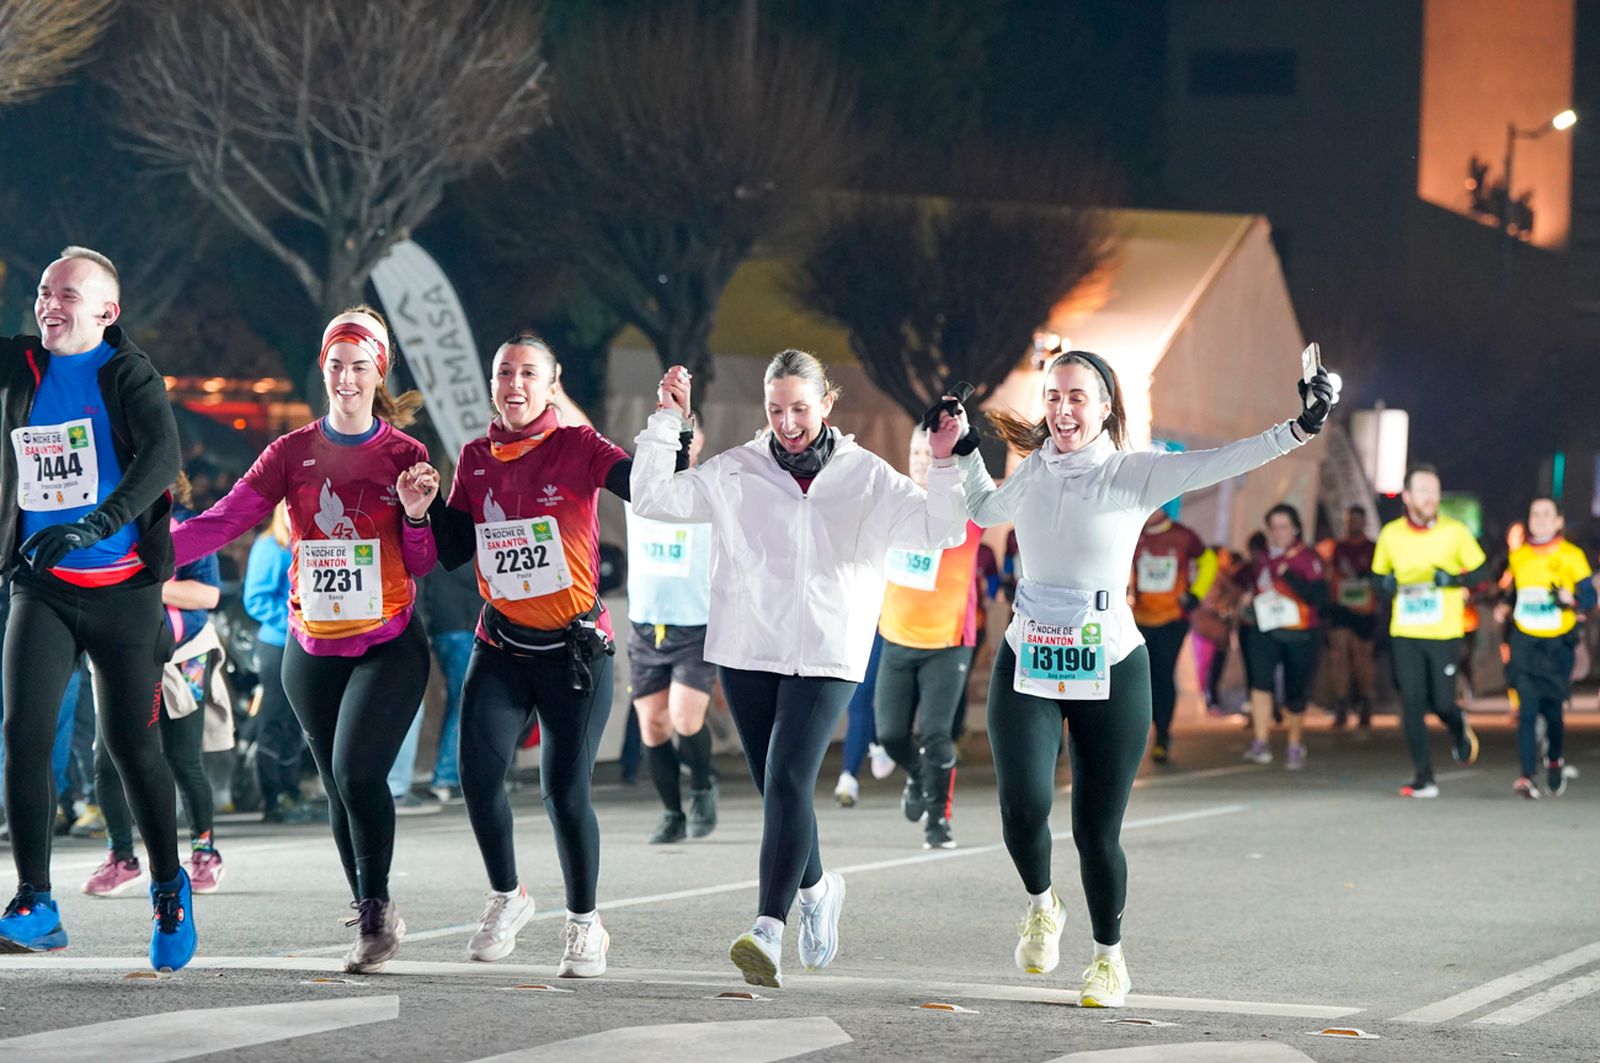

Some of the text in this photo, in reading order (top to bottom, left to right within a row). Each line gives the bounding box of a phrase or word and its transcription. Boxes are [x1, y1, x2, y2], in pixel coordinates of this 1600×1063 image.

[422, 284, 487, 431] PEMASA
[51, 434, 62, 443] DE
[25, 446, 40, 456] SAN
[33, 452, 83, 481] 7444
[492, 530, 516, 539] NOCHE
[516, 528, 526, 537] DE
[487, 541, 501, 550] SAN
[311, 548, 347, 557] NOCHE DE
[495, 544, 550, 574] 2232
[312, 568, 363, 593] 2231
[1037, 625, 1073, 635] NOCHE DE
[1027, 634, 1043, 644] SAN
[1032, 646, 1096, 671] 13190
